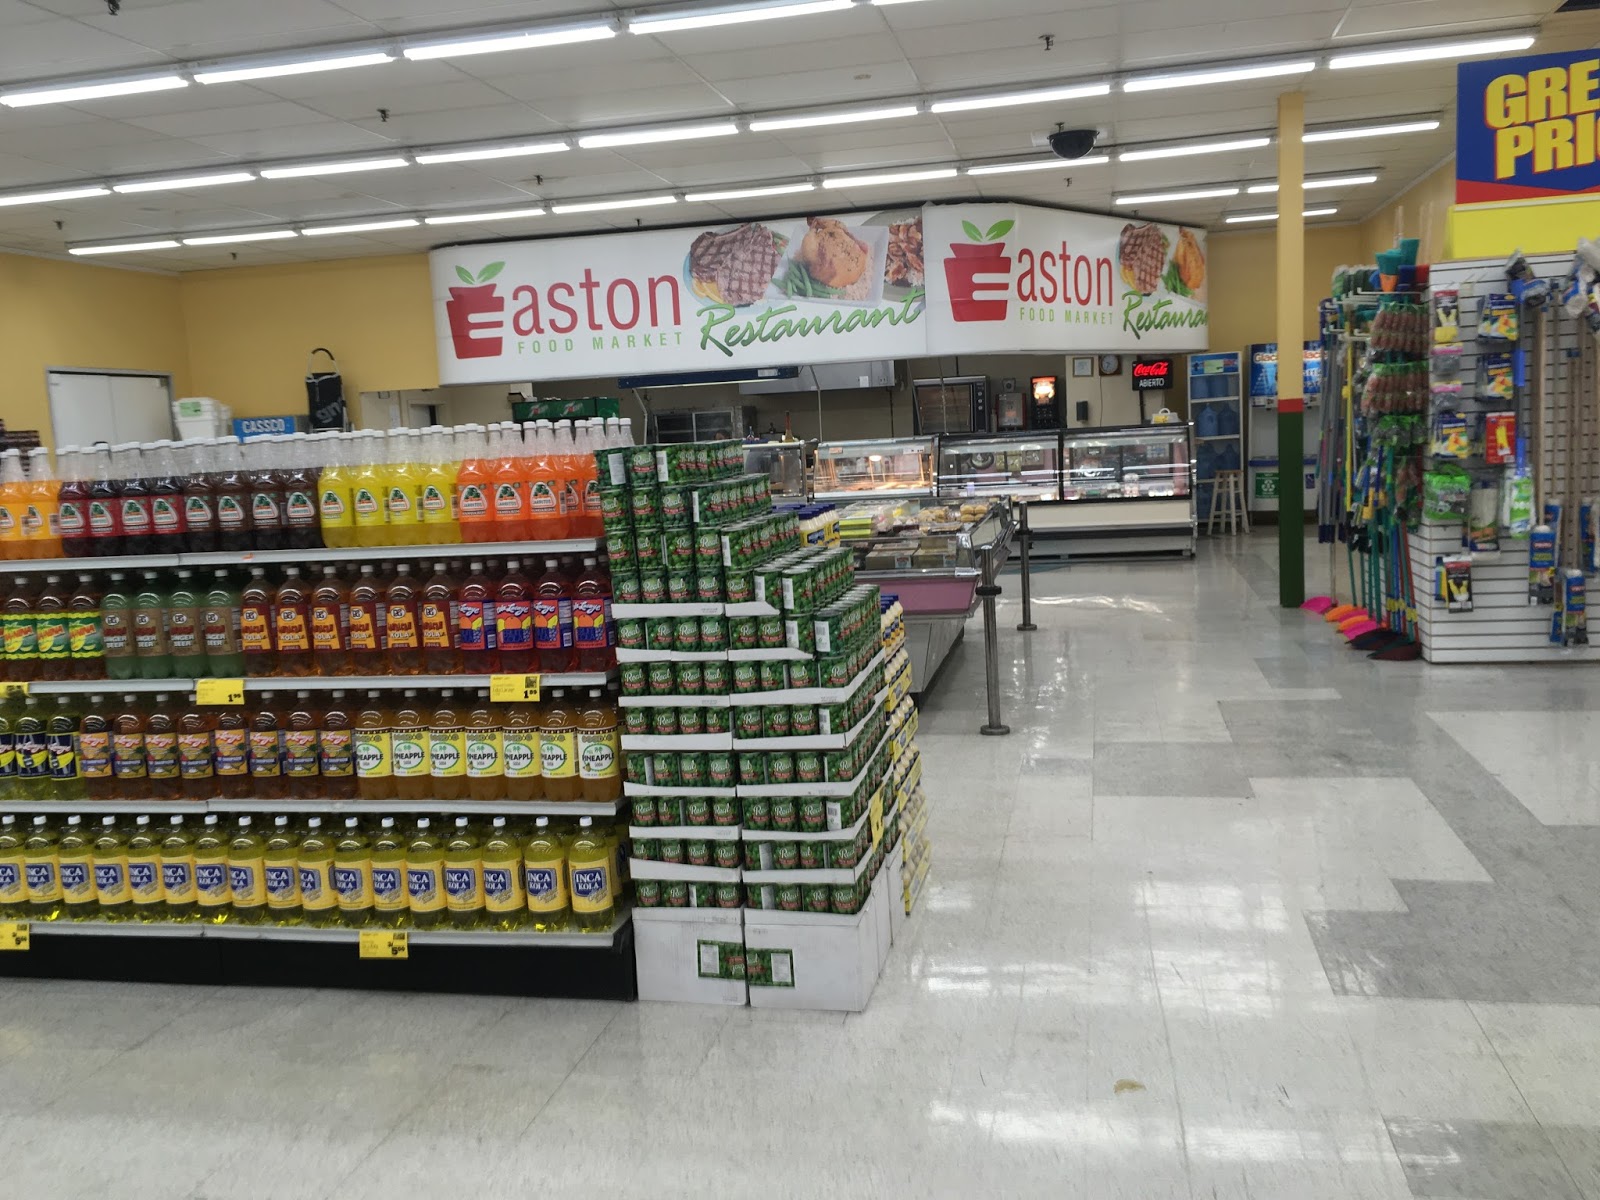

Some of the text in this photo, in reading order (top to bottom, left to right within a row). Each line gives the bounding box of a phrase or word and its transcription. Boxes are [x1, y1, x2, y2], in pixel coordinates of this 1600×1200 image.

[1494, 113, 1600, 181] PRI
[1019, 307, 1114, 326] FOOD MARKET
[697, 287, 925, 358] Restaurant
[518, 330, 683, 355] FOOD MARKET
[1139, 378, 1165, 388] ABIERTO
[241, 418, 286, 434] CASSCO
[26, 867, 48, 876] NCA
[61, 867, 82, 876] NCA
[95, 868, 116, 876] NCA
[129, 867, 150, 875] NCA
[163, 867, 184, 876] NCA
[231, 870, 247, 879] NCA
[266, 871, 287, 880] NCA
[336, 873, 355, 881] NCA
[409, 874, 429, 882] NCA
[485, 873, 505, 882] NCA
[576, 872, 601, 883] INCA
